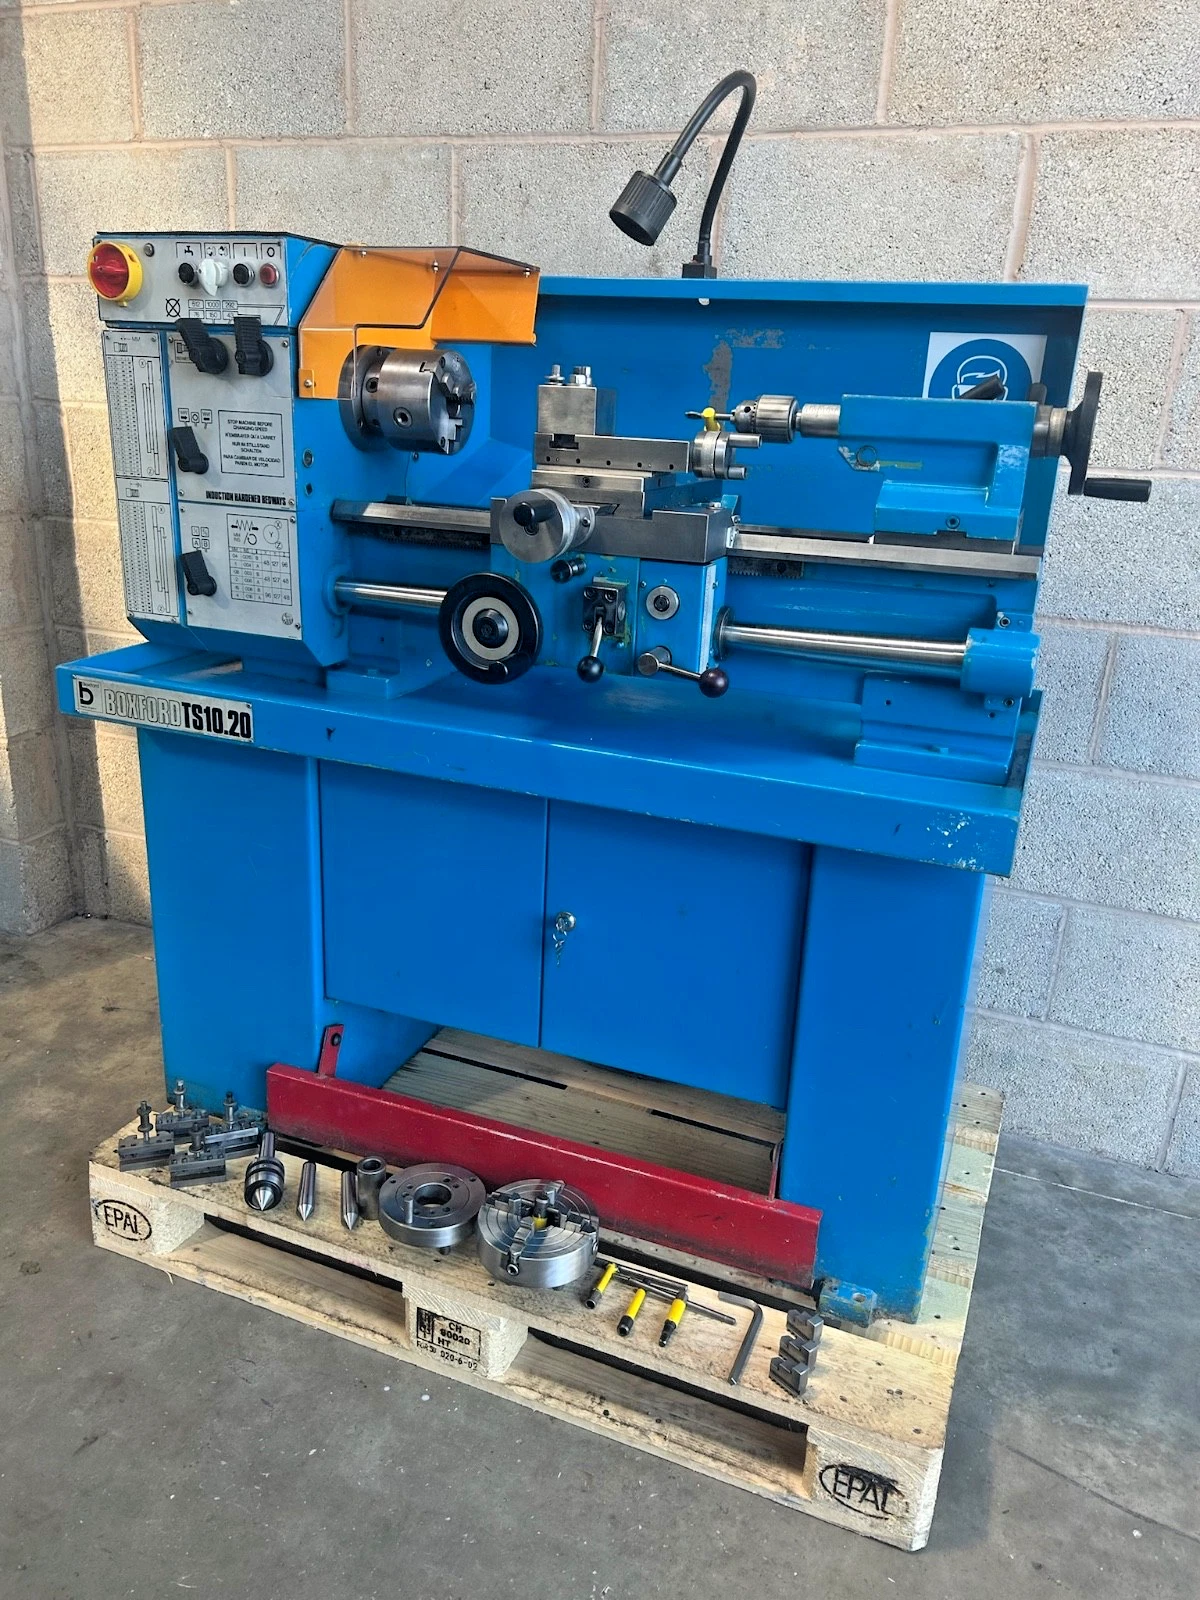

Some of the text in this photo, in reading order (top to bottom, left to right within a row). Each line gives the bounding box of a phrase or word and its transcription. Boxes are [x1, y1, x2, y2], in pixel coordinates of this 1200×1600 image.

[206, 490, 233, 500] INDUCTION
[104, 688, 252, 740] BOXFORD TS10.20
[449, 1322, 462, 1334] CH
[438, 1337, 451, 1348] HT
